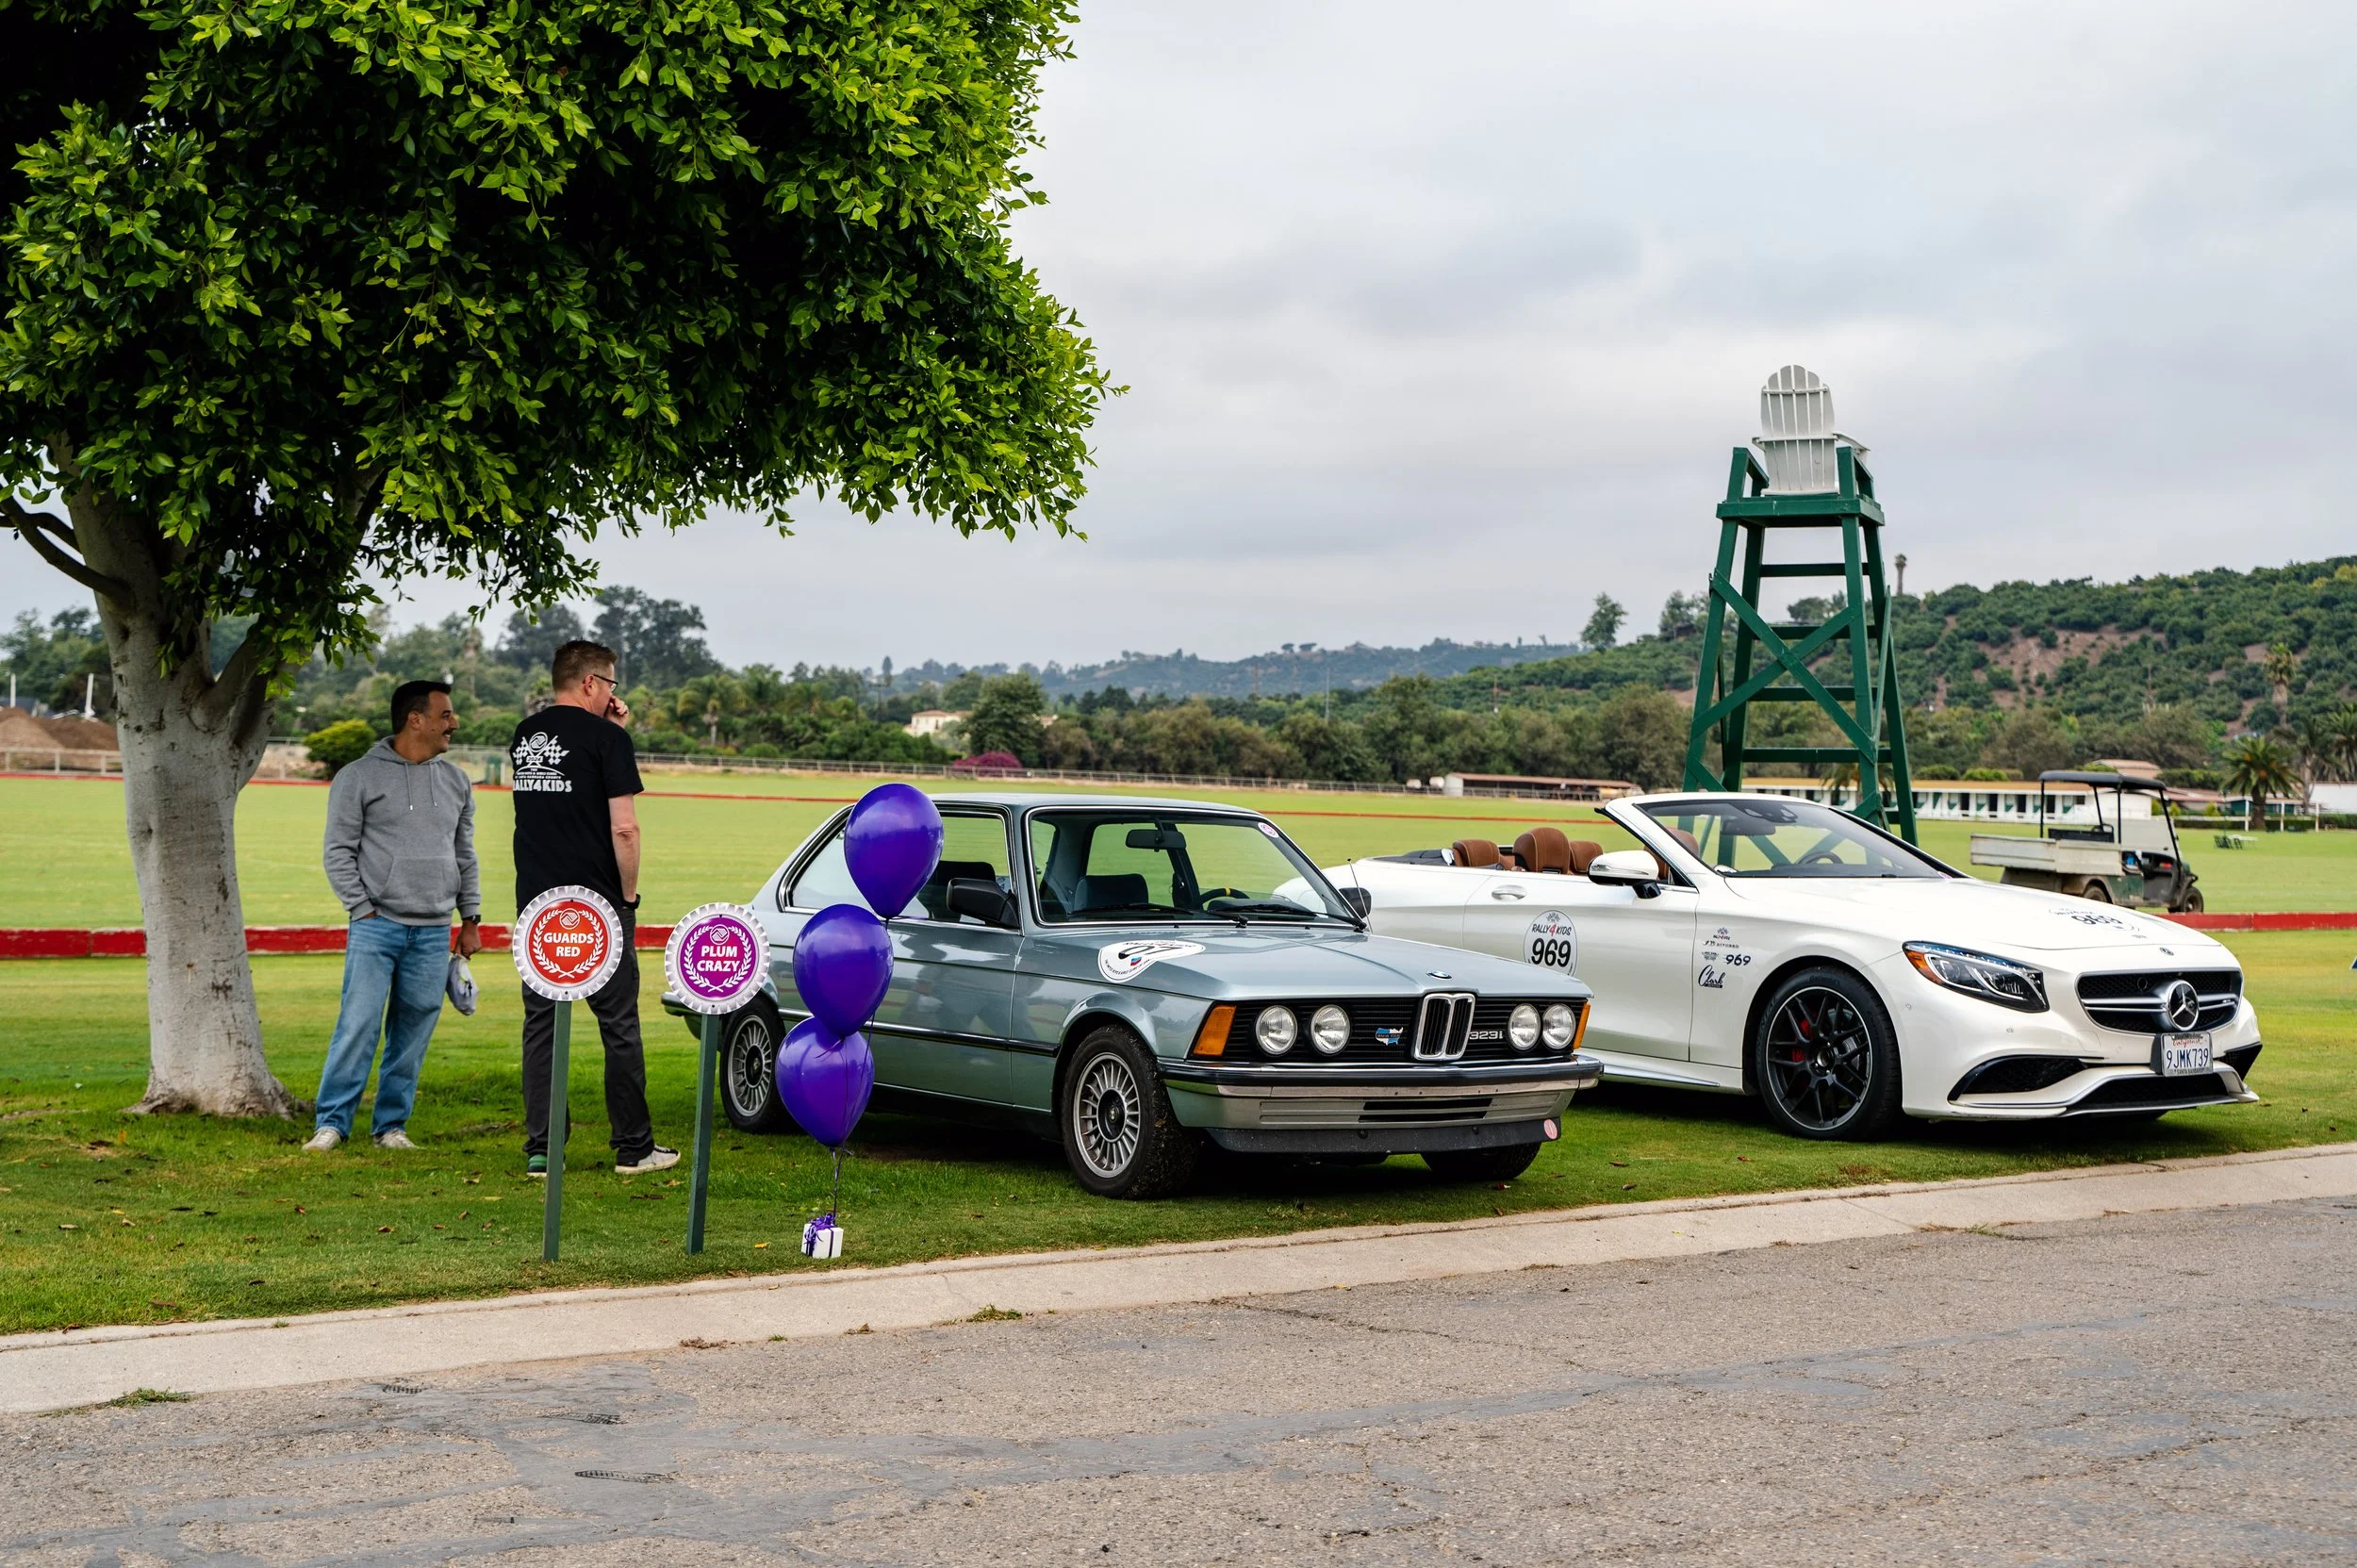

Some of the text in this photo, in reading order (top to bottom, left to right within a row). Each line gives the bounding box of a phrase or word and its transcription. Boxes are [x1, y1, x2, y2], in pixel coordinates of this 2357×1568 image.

[543, 932, 595, 944] GUARDS
[555, 946, 581, 957] RED
[701, 945, 738, 957] PLUM
[1531, 937, 1572, 967] 969
[1724, 953, 1752, 966] 969
[696, 960, 741, 972] CRAZY
[1469, 1031, 1504, 1040] 323i
[2166, 1048, 2209, 1069] 9JMK739
